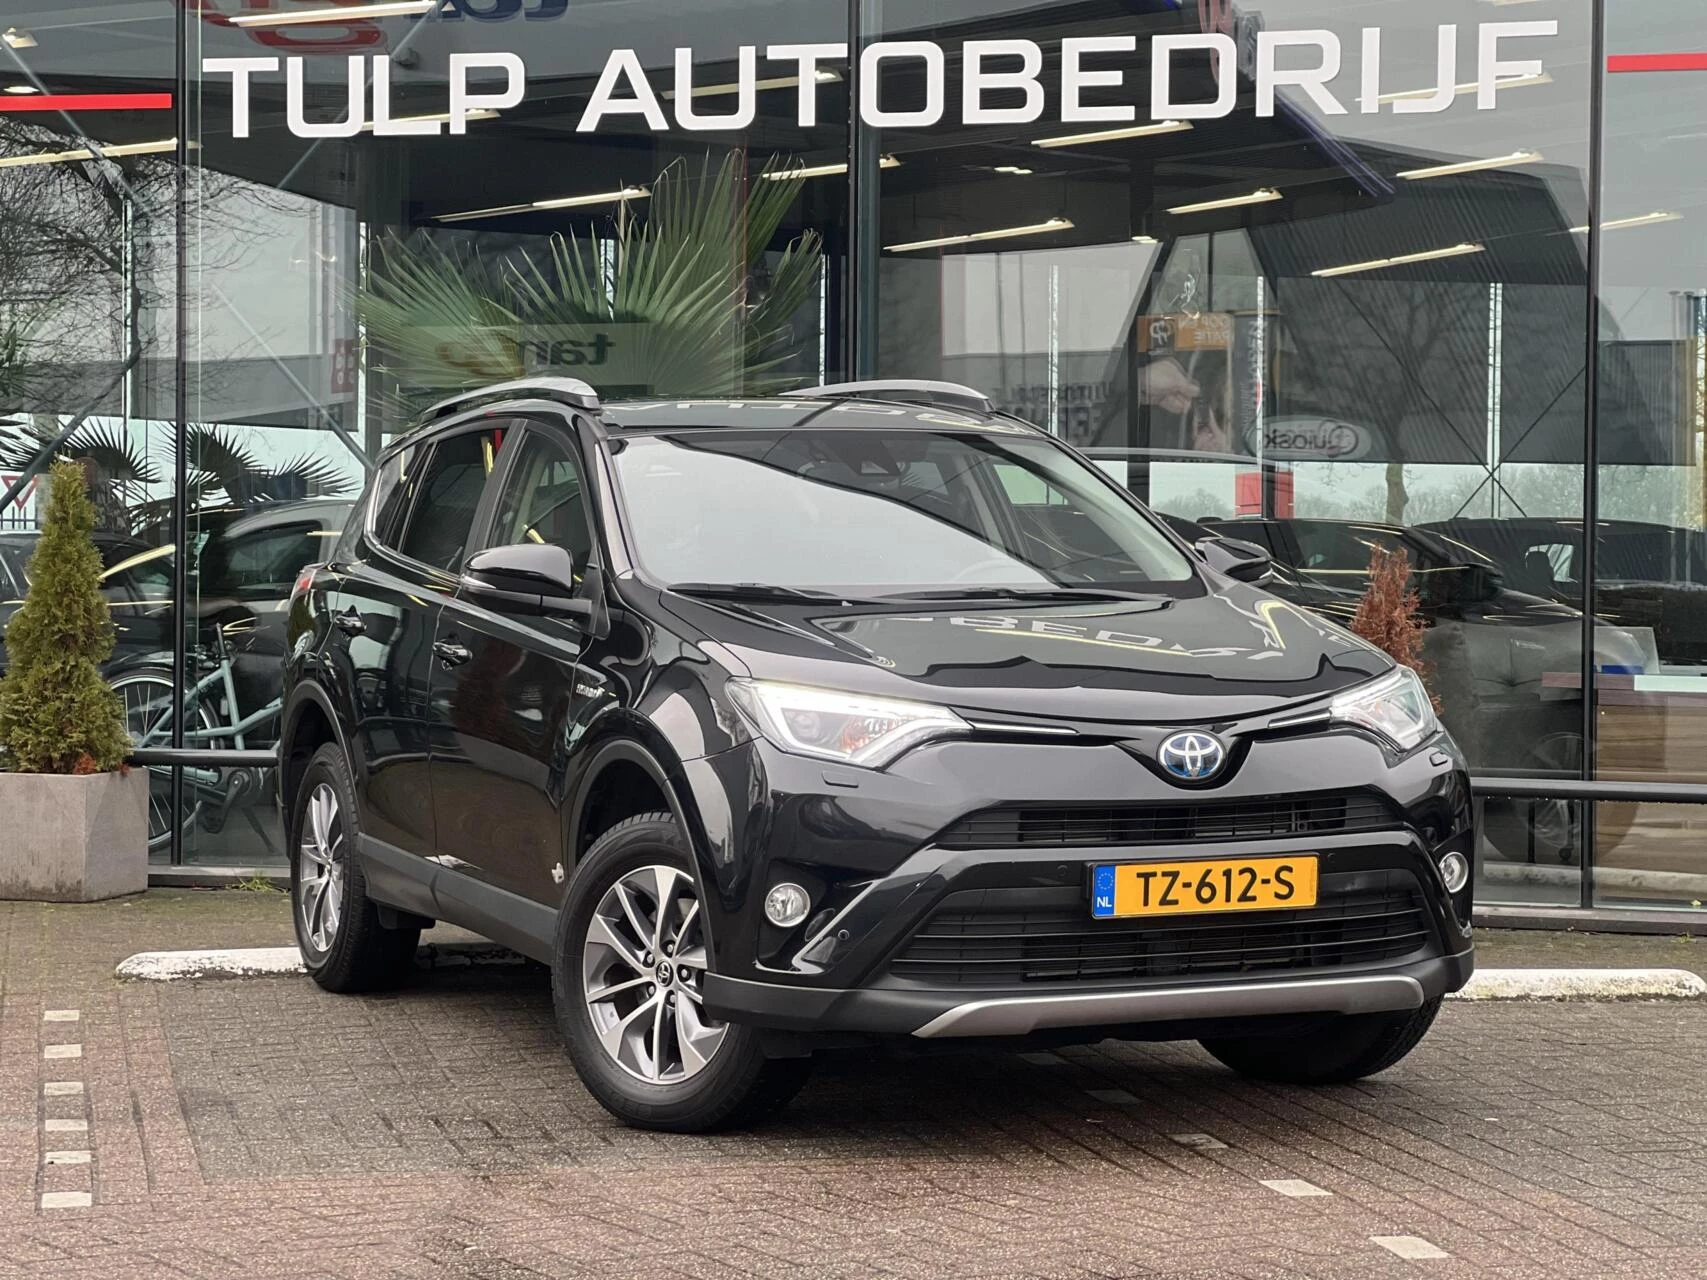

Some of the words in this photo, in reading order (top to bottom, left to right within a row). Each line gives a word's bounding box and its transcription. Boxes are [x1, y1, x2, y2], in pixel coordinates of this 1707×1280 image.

[202, 52, 525, 138] TULP
[576, 20, 1559, 133] AUTOBEDRIJF
[1096, 897, 1112, 908] NL
[1136, 865, 1295, 907] TZ-612-S
